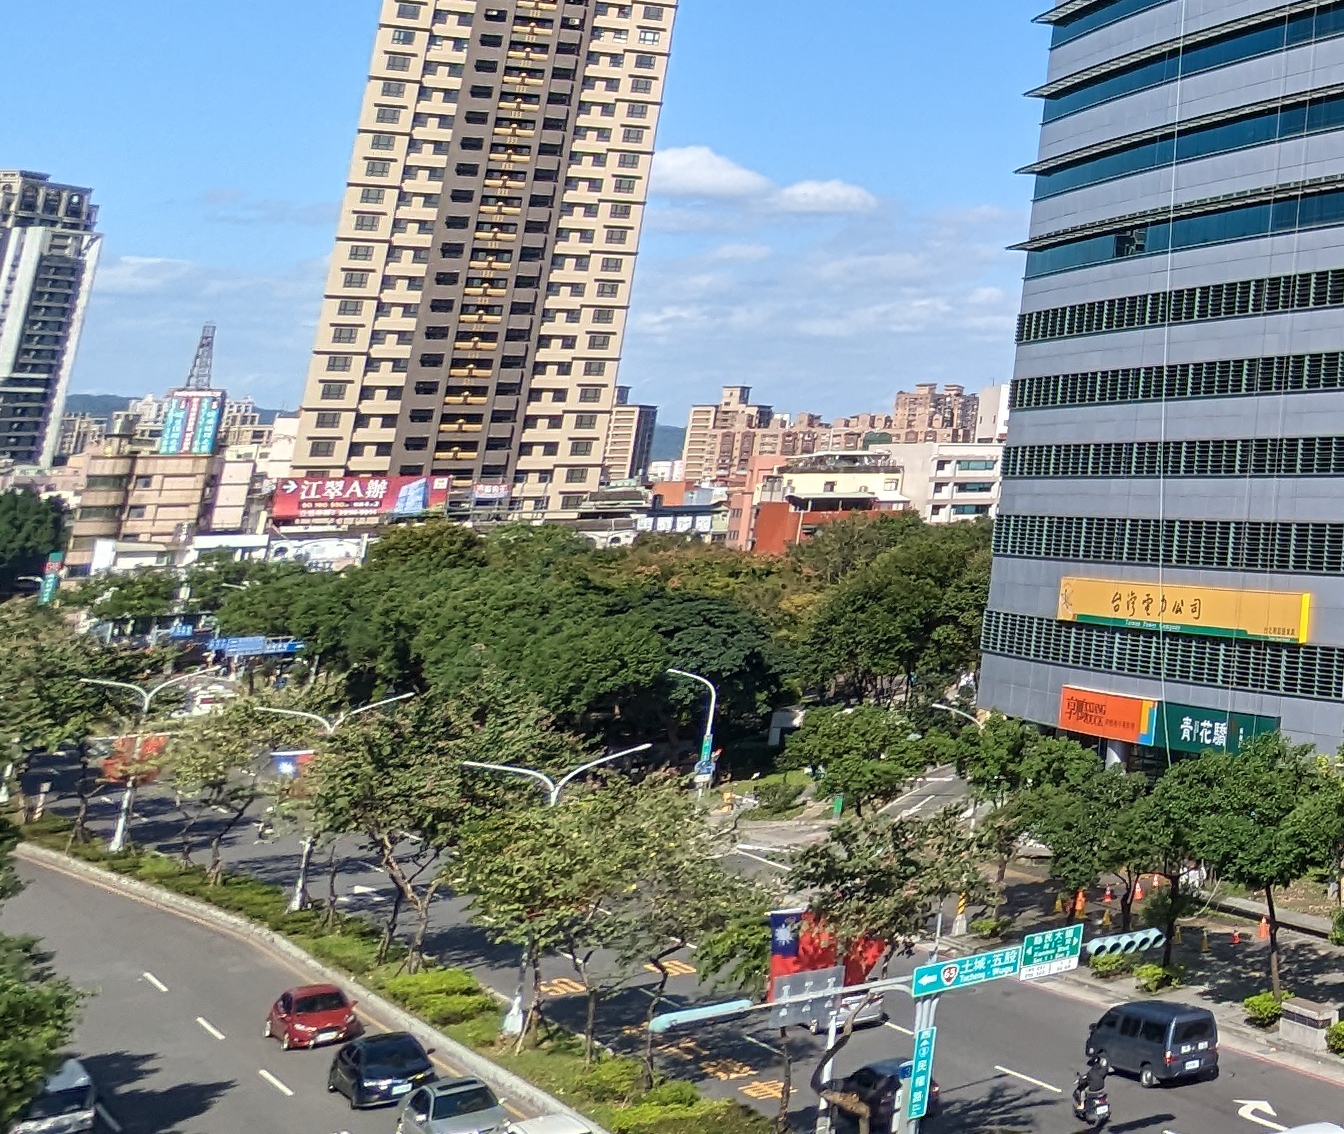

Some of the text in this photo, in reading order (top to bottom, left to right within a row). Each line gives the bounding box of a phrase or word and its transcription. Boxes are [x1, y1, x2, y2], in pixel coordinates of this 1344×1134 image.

[1111, 590, 1202, 620] 台灣電力公司
